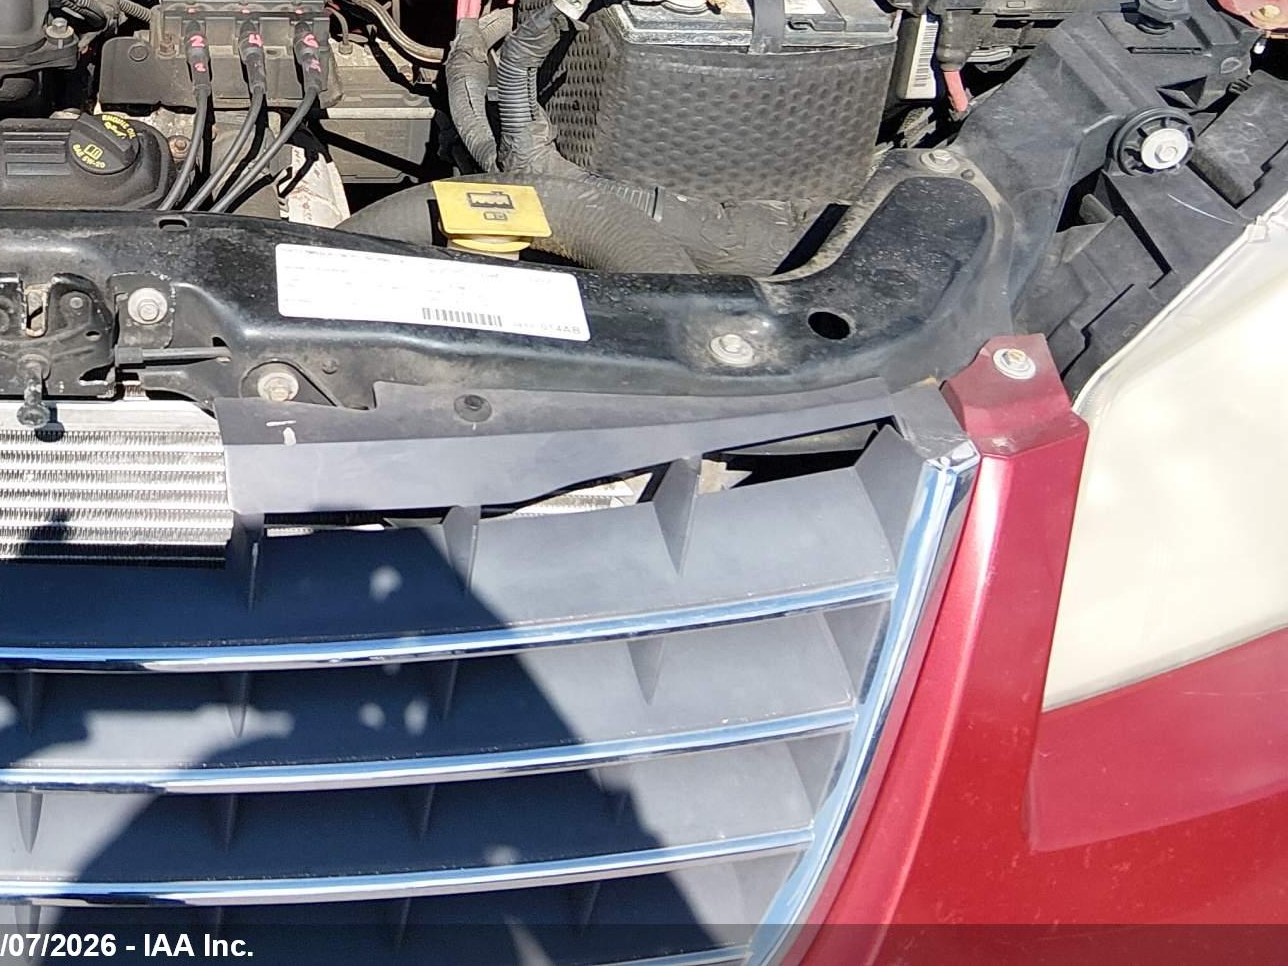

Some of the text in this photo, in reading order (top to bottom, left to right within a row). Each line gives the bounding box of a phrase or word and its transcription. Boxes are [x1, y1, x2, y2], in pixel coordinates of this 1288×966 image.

[102, 114, 137, 140] ENGINE OIL
[72, 143, 106, 169] SAE 5W-20
